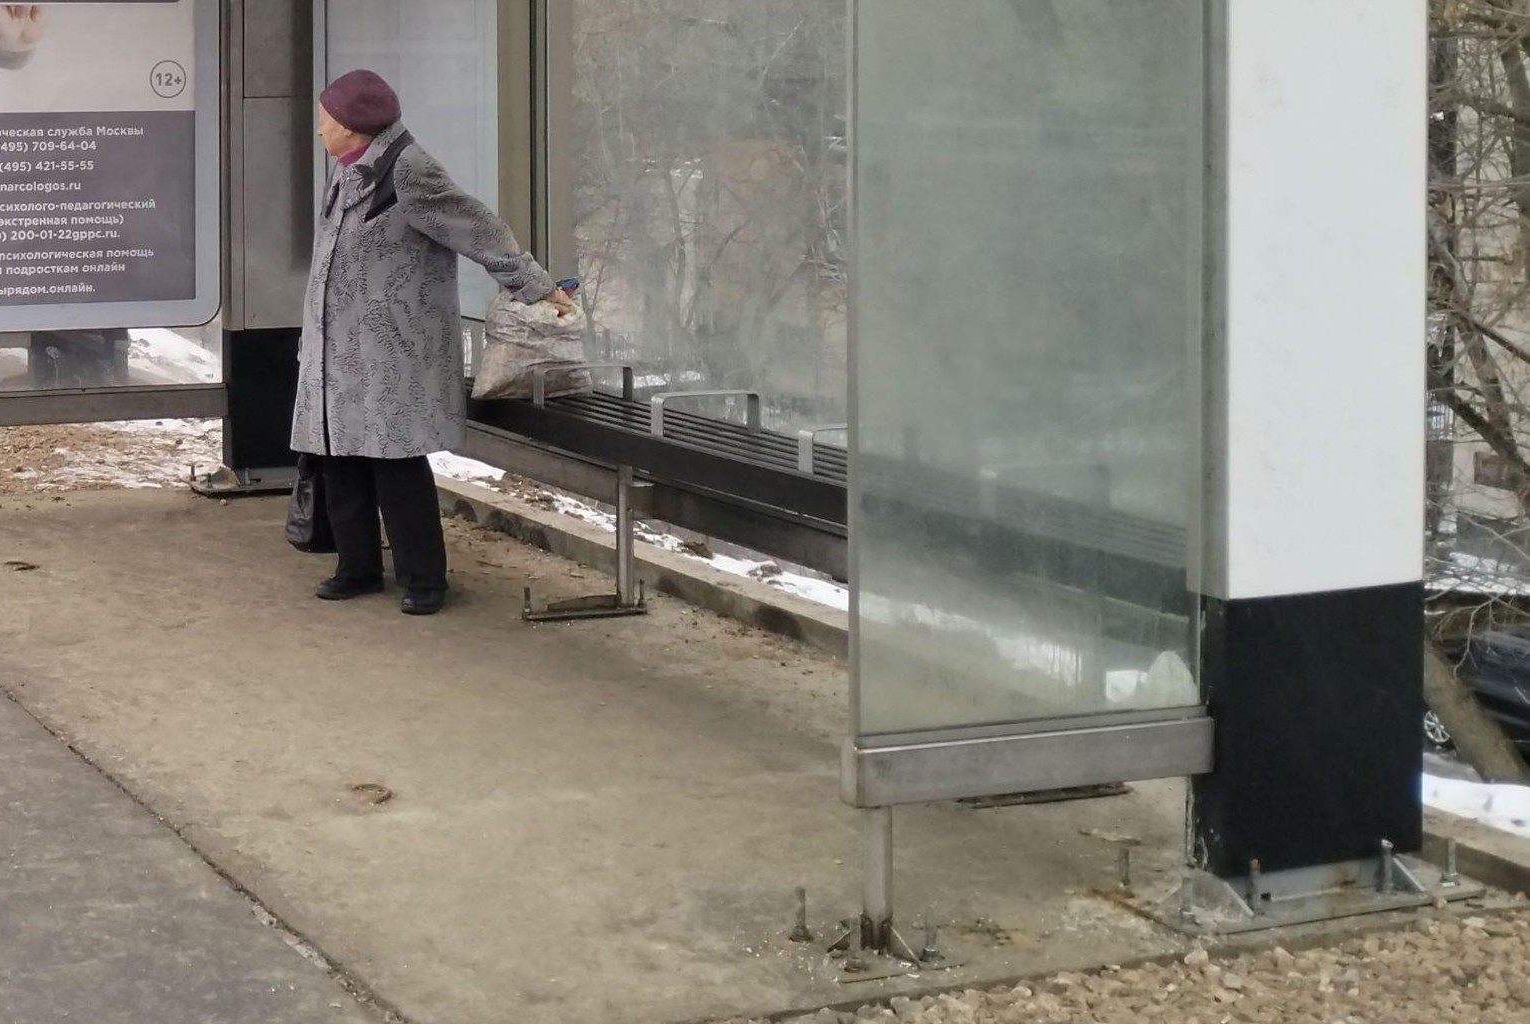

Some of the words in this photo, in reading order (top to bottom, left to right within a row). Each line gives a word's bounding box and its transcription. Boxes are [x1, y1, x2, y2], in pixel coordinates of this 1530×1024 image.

[154, 72, 183, 88] 12+
[47, 126, 93, 138] служба
[96, 126, 144, 137] Москвы
[32, 141, 97, 151] 709-64-04
[35, 160, 95, 171] 421-55-55
[0, 181, 81, 193] narcologos.ru
[70, 214, 125, 226] помощь)
[106, 248, 155, 259] помощь
[5, 264, 79, 276] подросткам
[82, 262, 125, 273] онлайн
